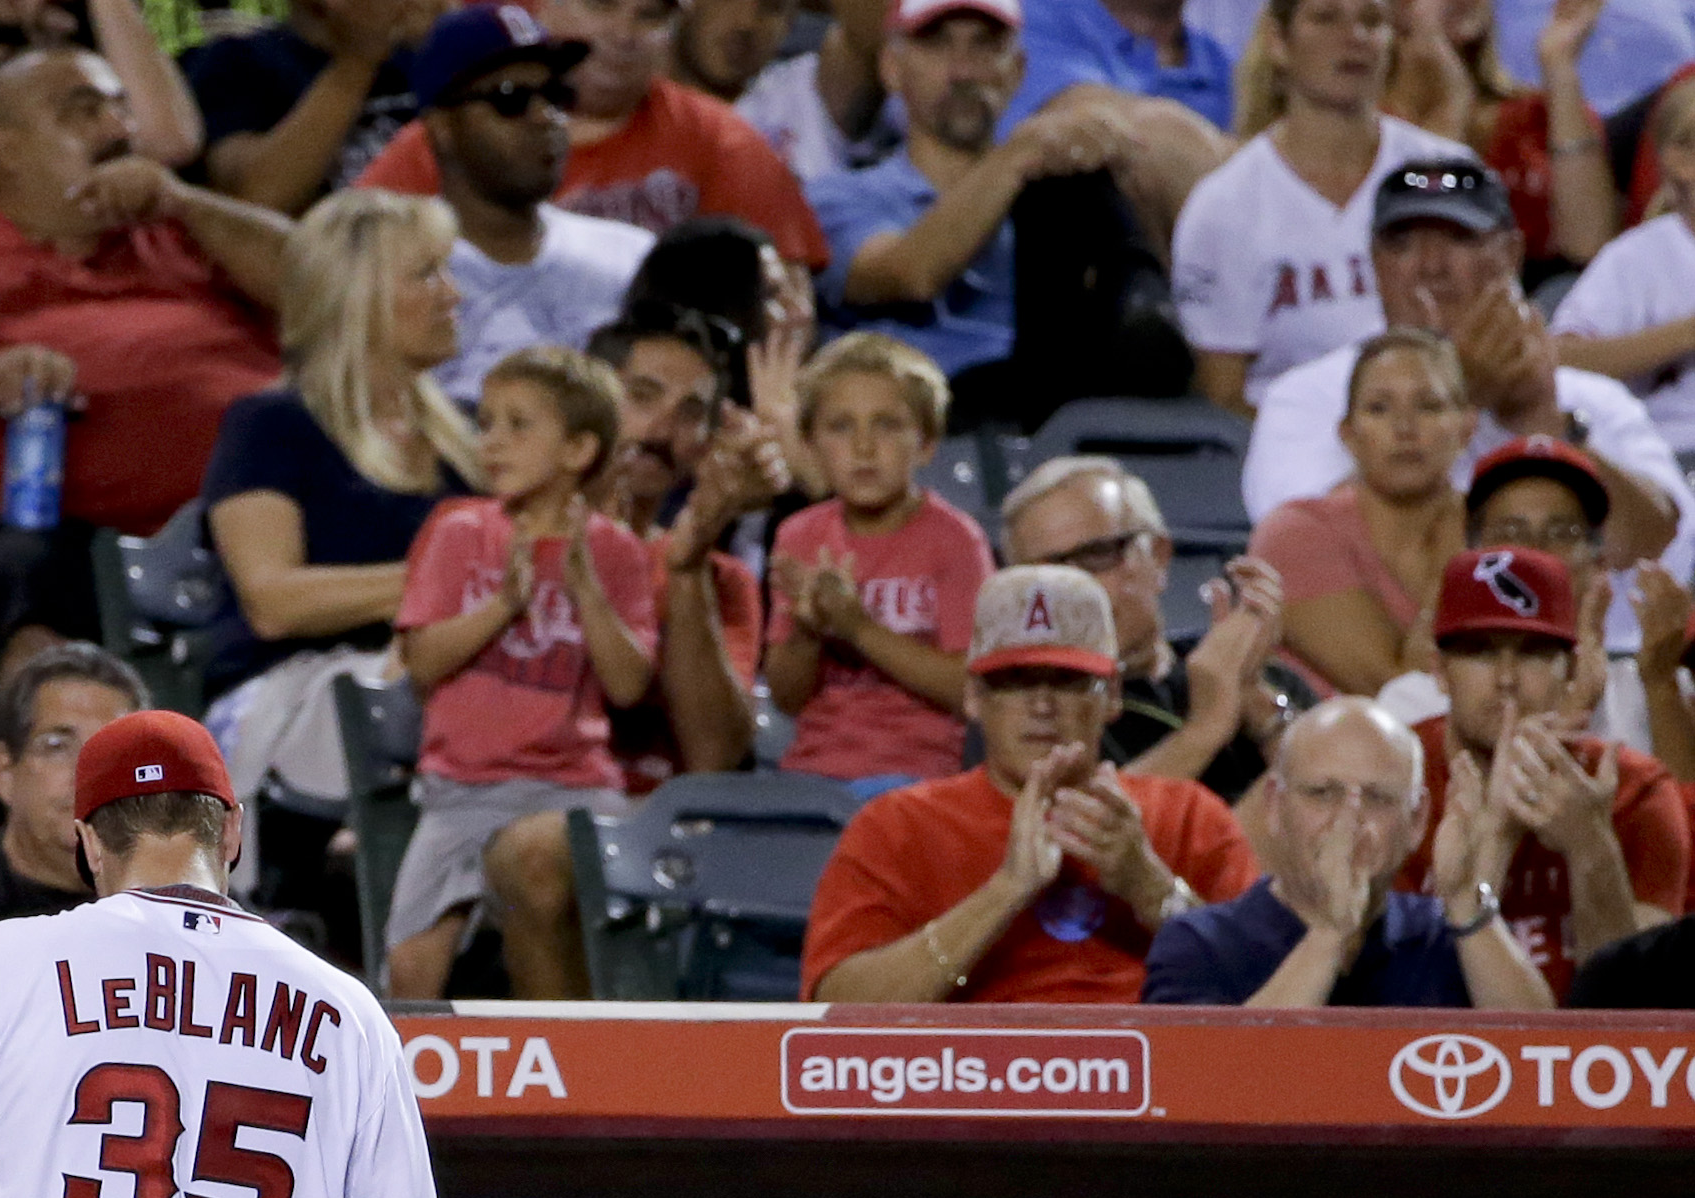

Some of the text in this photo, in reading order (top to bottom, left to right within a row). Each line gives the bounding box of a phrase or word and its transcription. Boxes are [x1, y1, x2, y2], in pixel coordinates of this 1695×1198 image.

[1026, 588, 1054, 632] A
[403, 1034, 568, 1099] OTA
[800, 1047, 1130, 1103] angels.com
[1520, 1045, 1695, 1109] TOY
